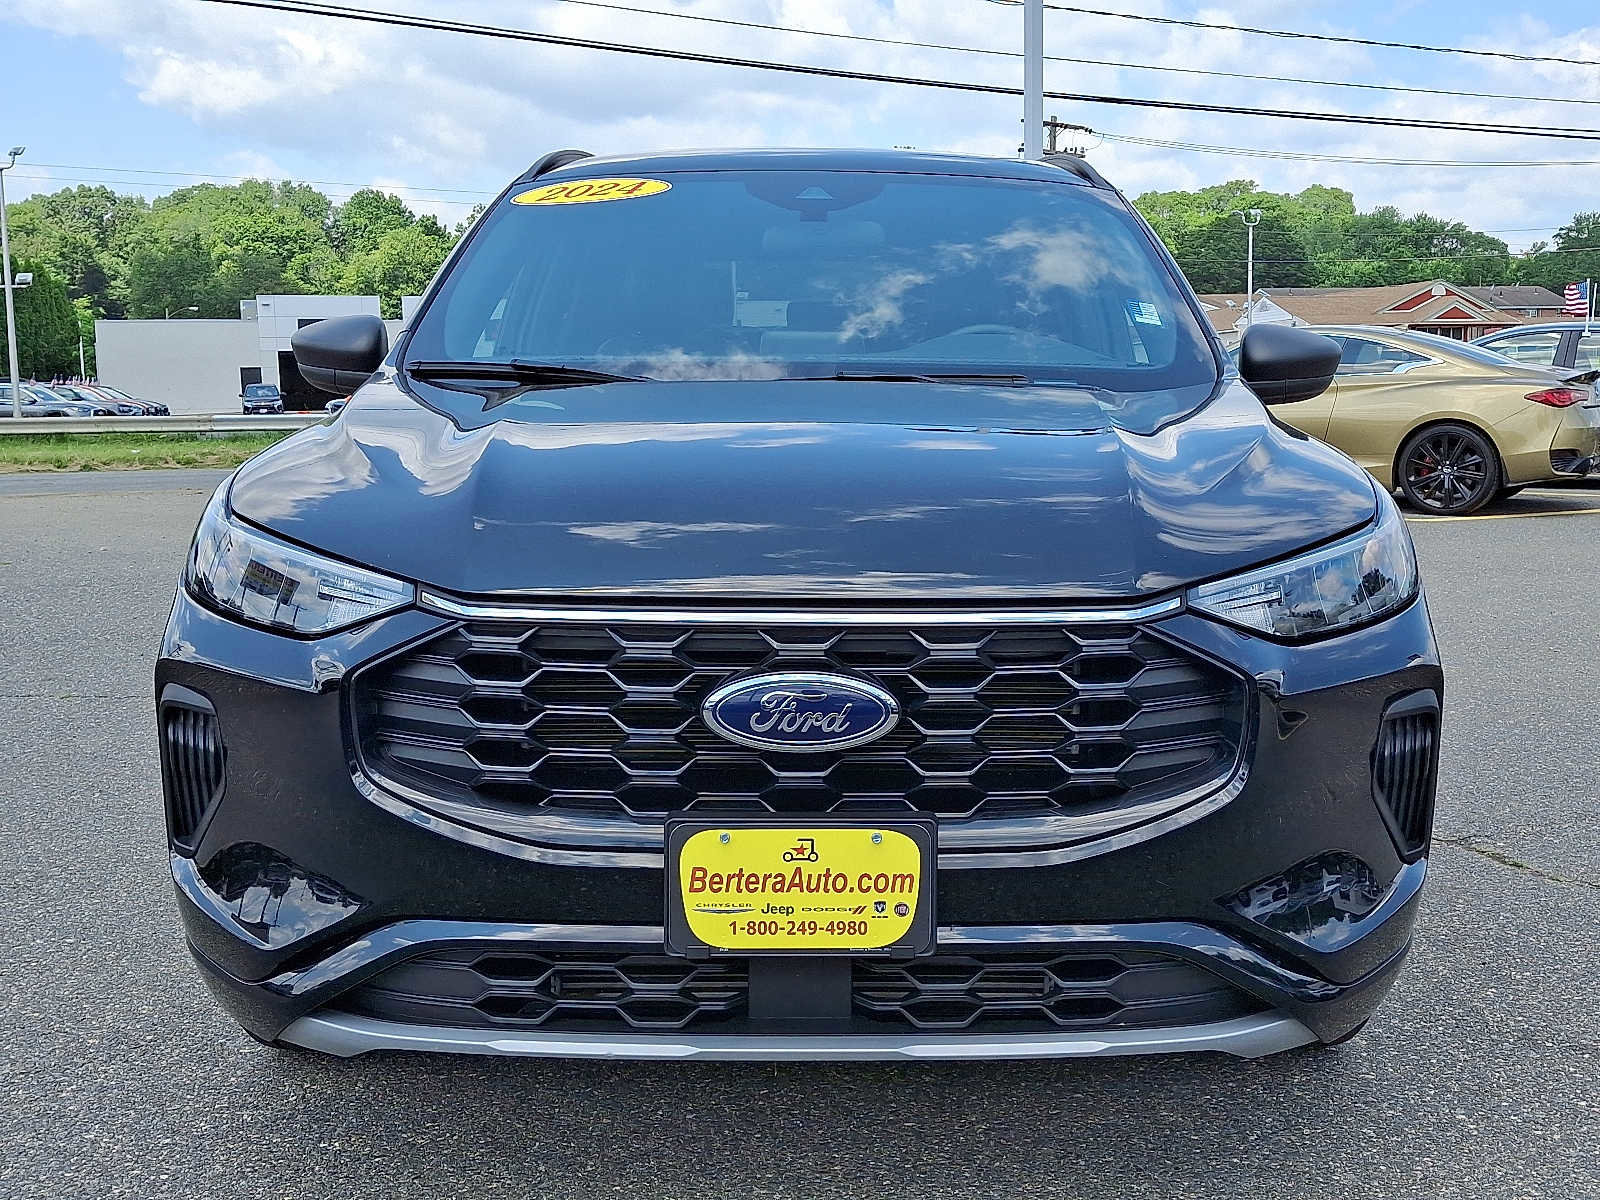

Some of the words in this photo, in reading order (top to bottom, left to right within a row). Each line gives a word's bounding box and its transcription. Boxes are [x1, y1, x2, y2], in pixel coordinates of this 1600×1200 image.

[535, 181, 647, 202] 2024
[750, 691, 853, 733] Ford
[688, 866, 915, 894] BerteraAuto.com
[761, 903, 795, 917] Jeep
[729, 920, 868, 936] 1-800-249-4980
